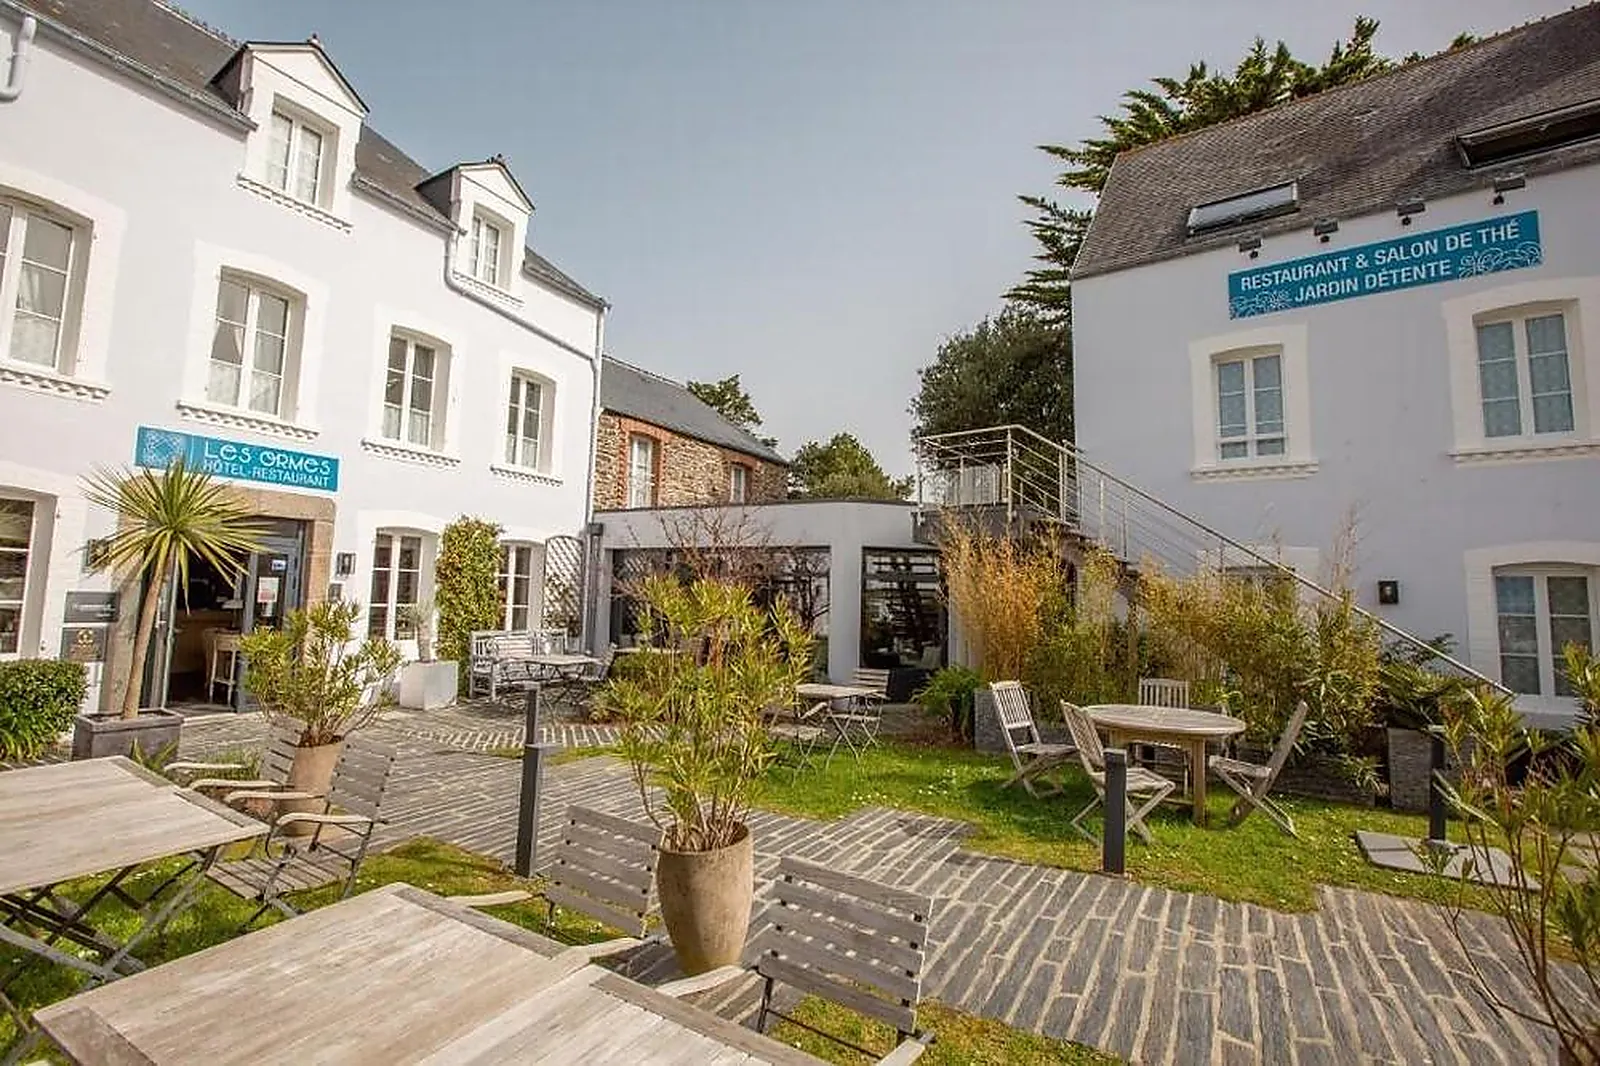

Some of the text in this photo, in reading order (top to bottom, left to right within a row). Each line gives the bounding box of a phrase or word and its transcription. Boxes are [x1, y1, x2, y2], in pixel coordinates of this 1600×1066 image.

[1241, 220, 1520, 291] RESTAURANT & SALON DE THÉ
[1295, 259, 1451, 302] JARDIN DÉTENTE
